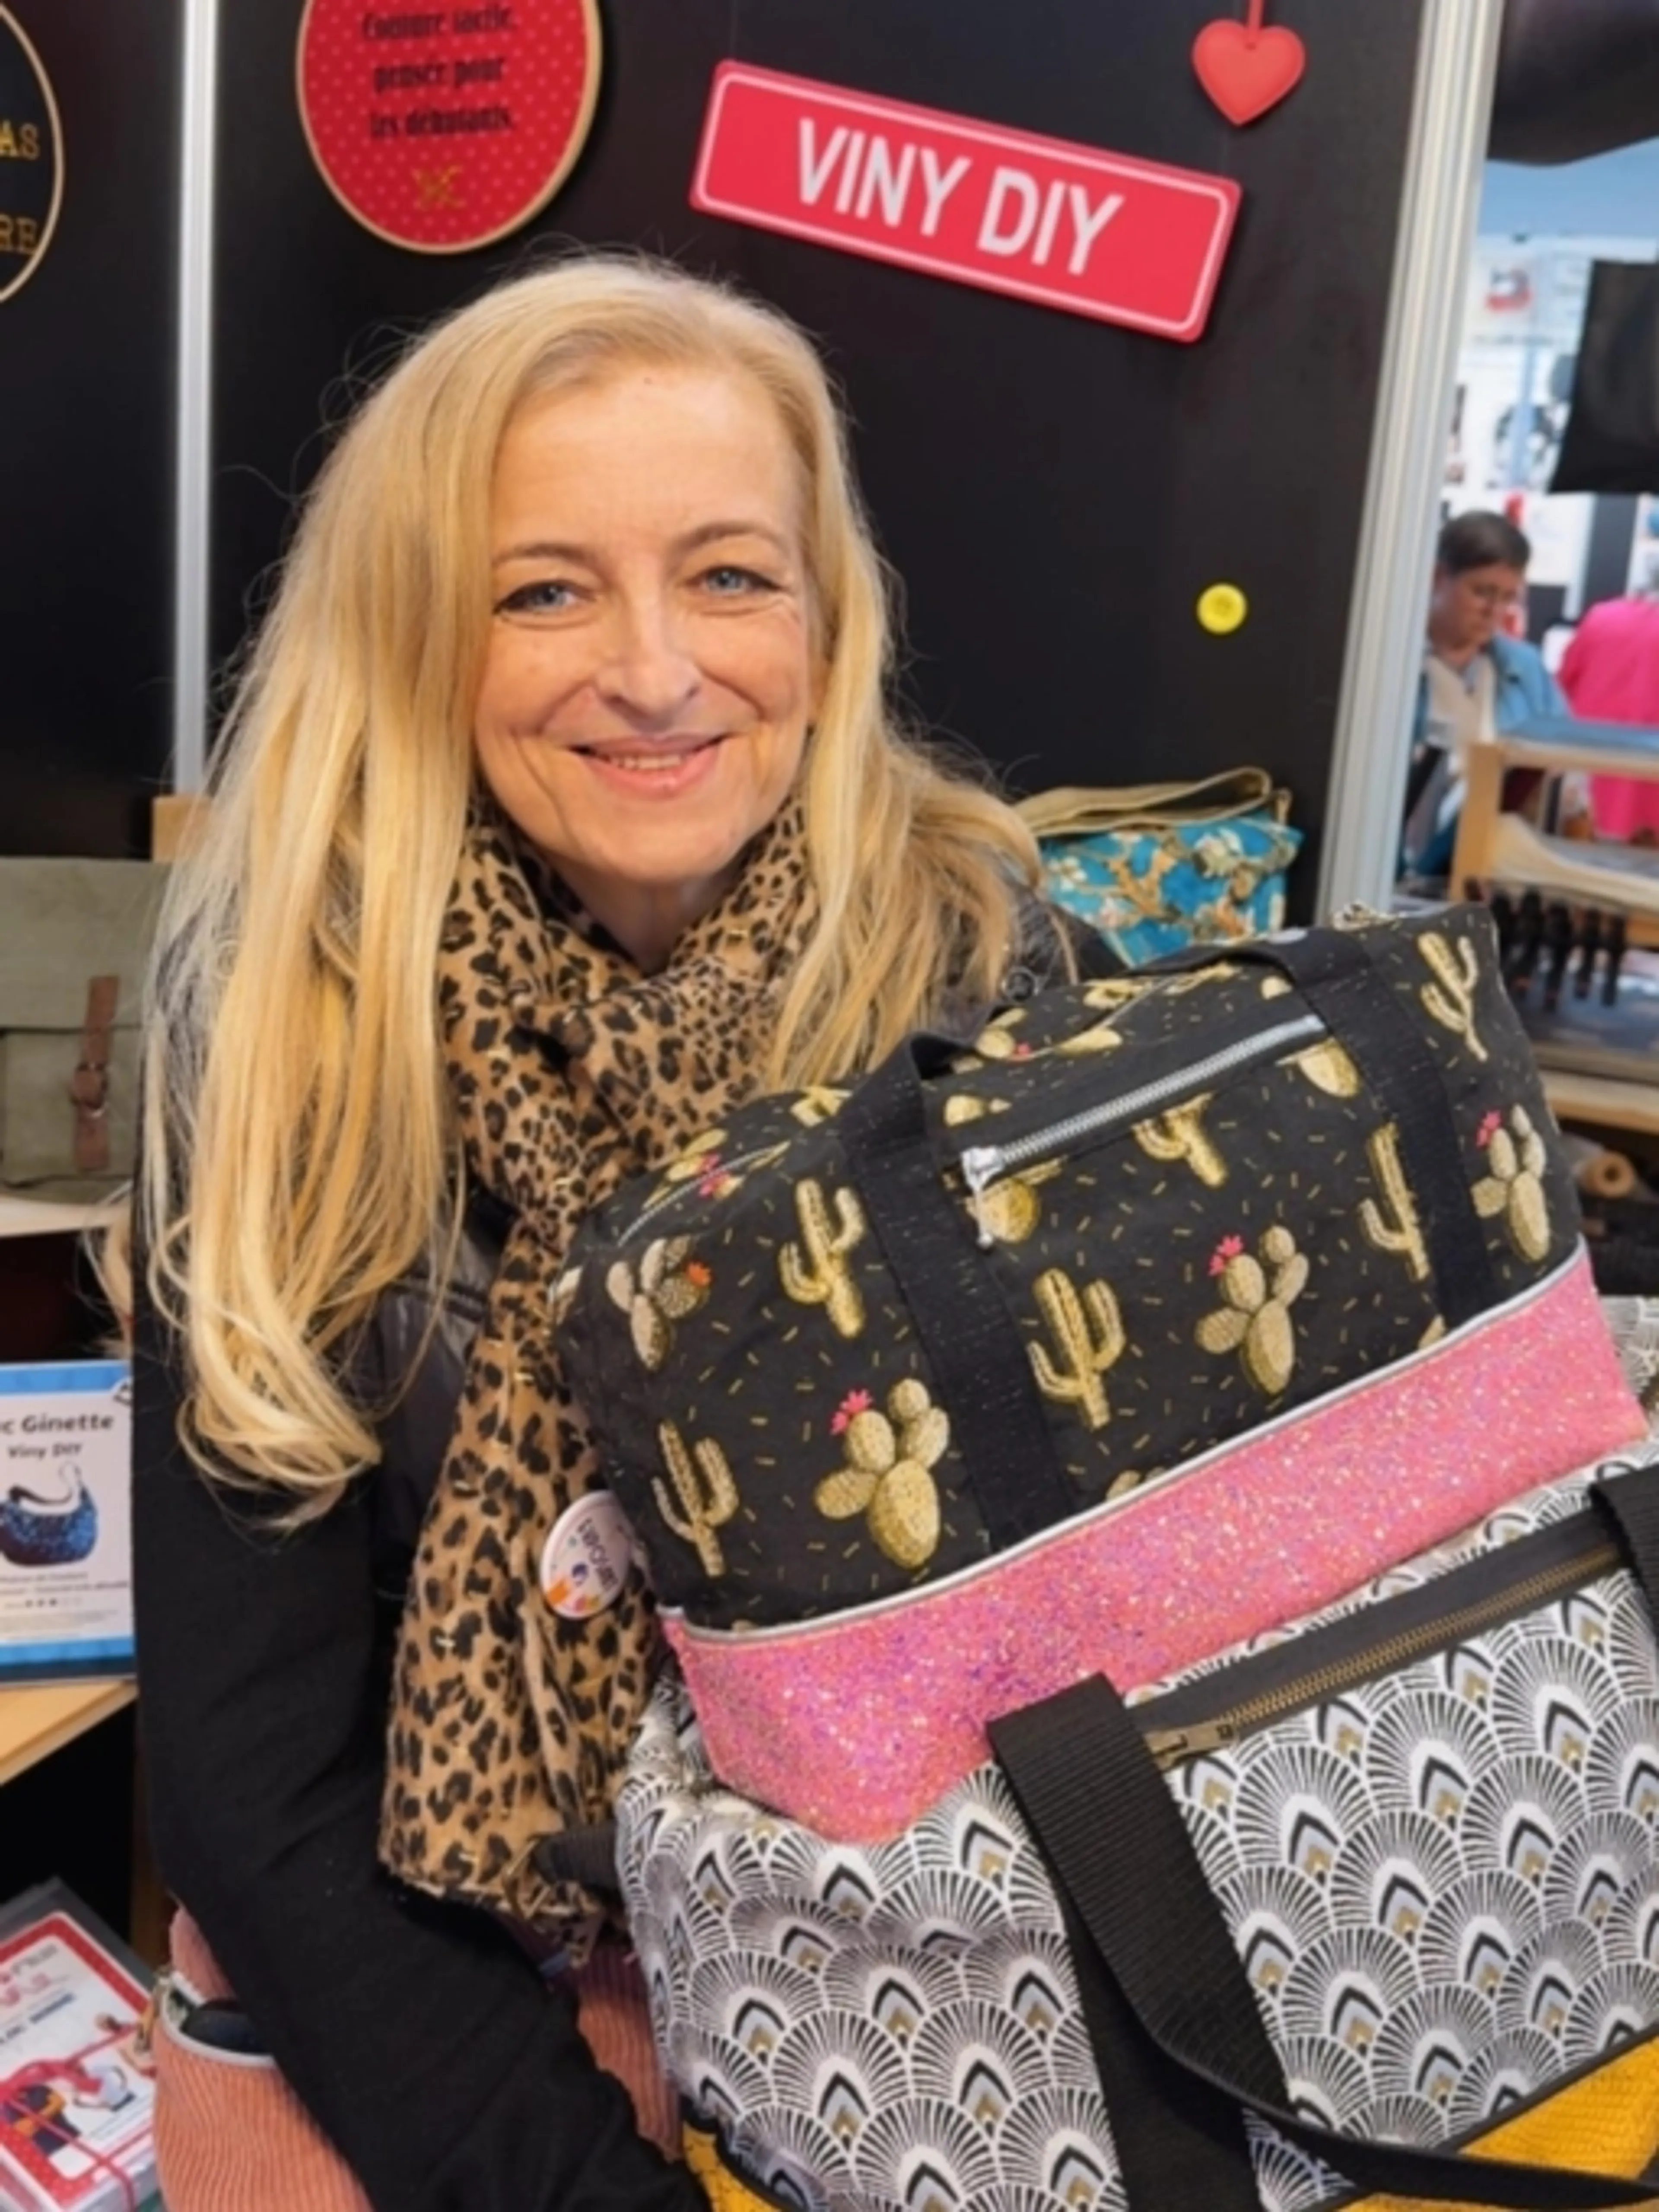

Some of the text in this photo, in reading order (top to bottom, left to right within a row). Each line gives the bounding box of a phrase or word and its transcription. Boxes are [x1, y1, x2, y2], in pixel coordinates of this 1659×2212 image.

[799, 118, 1125, 276] VINY DIY
[21, 1412, 114, 1435] Ginette
